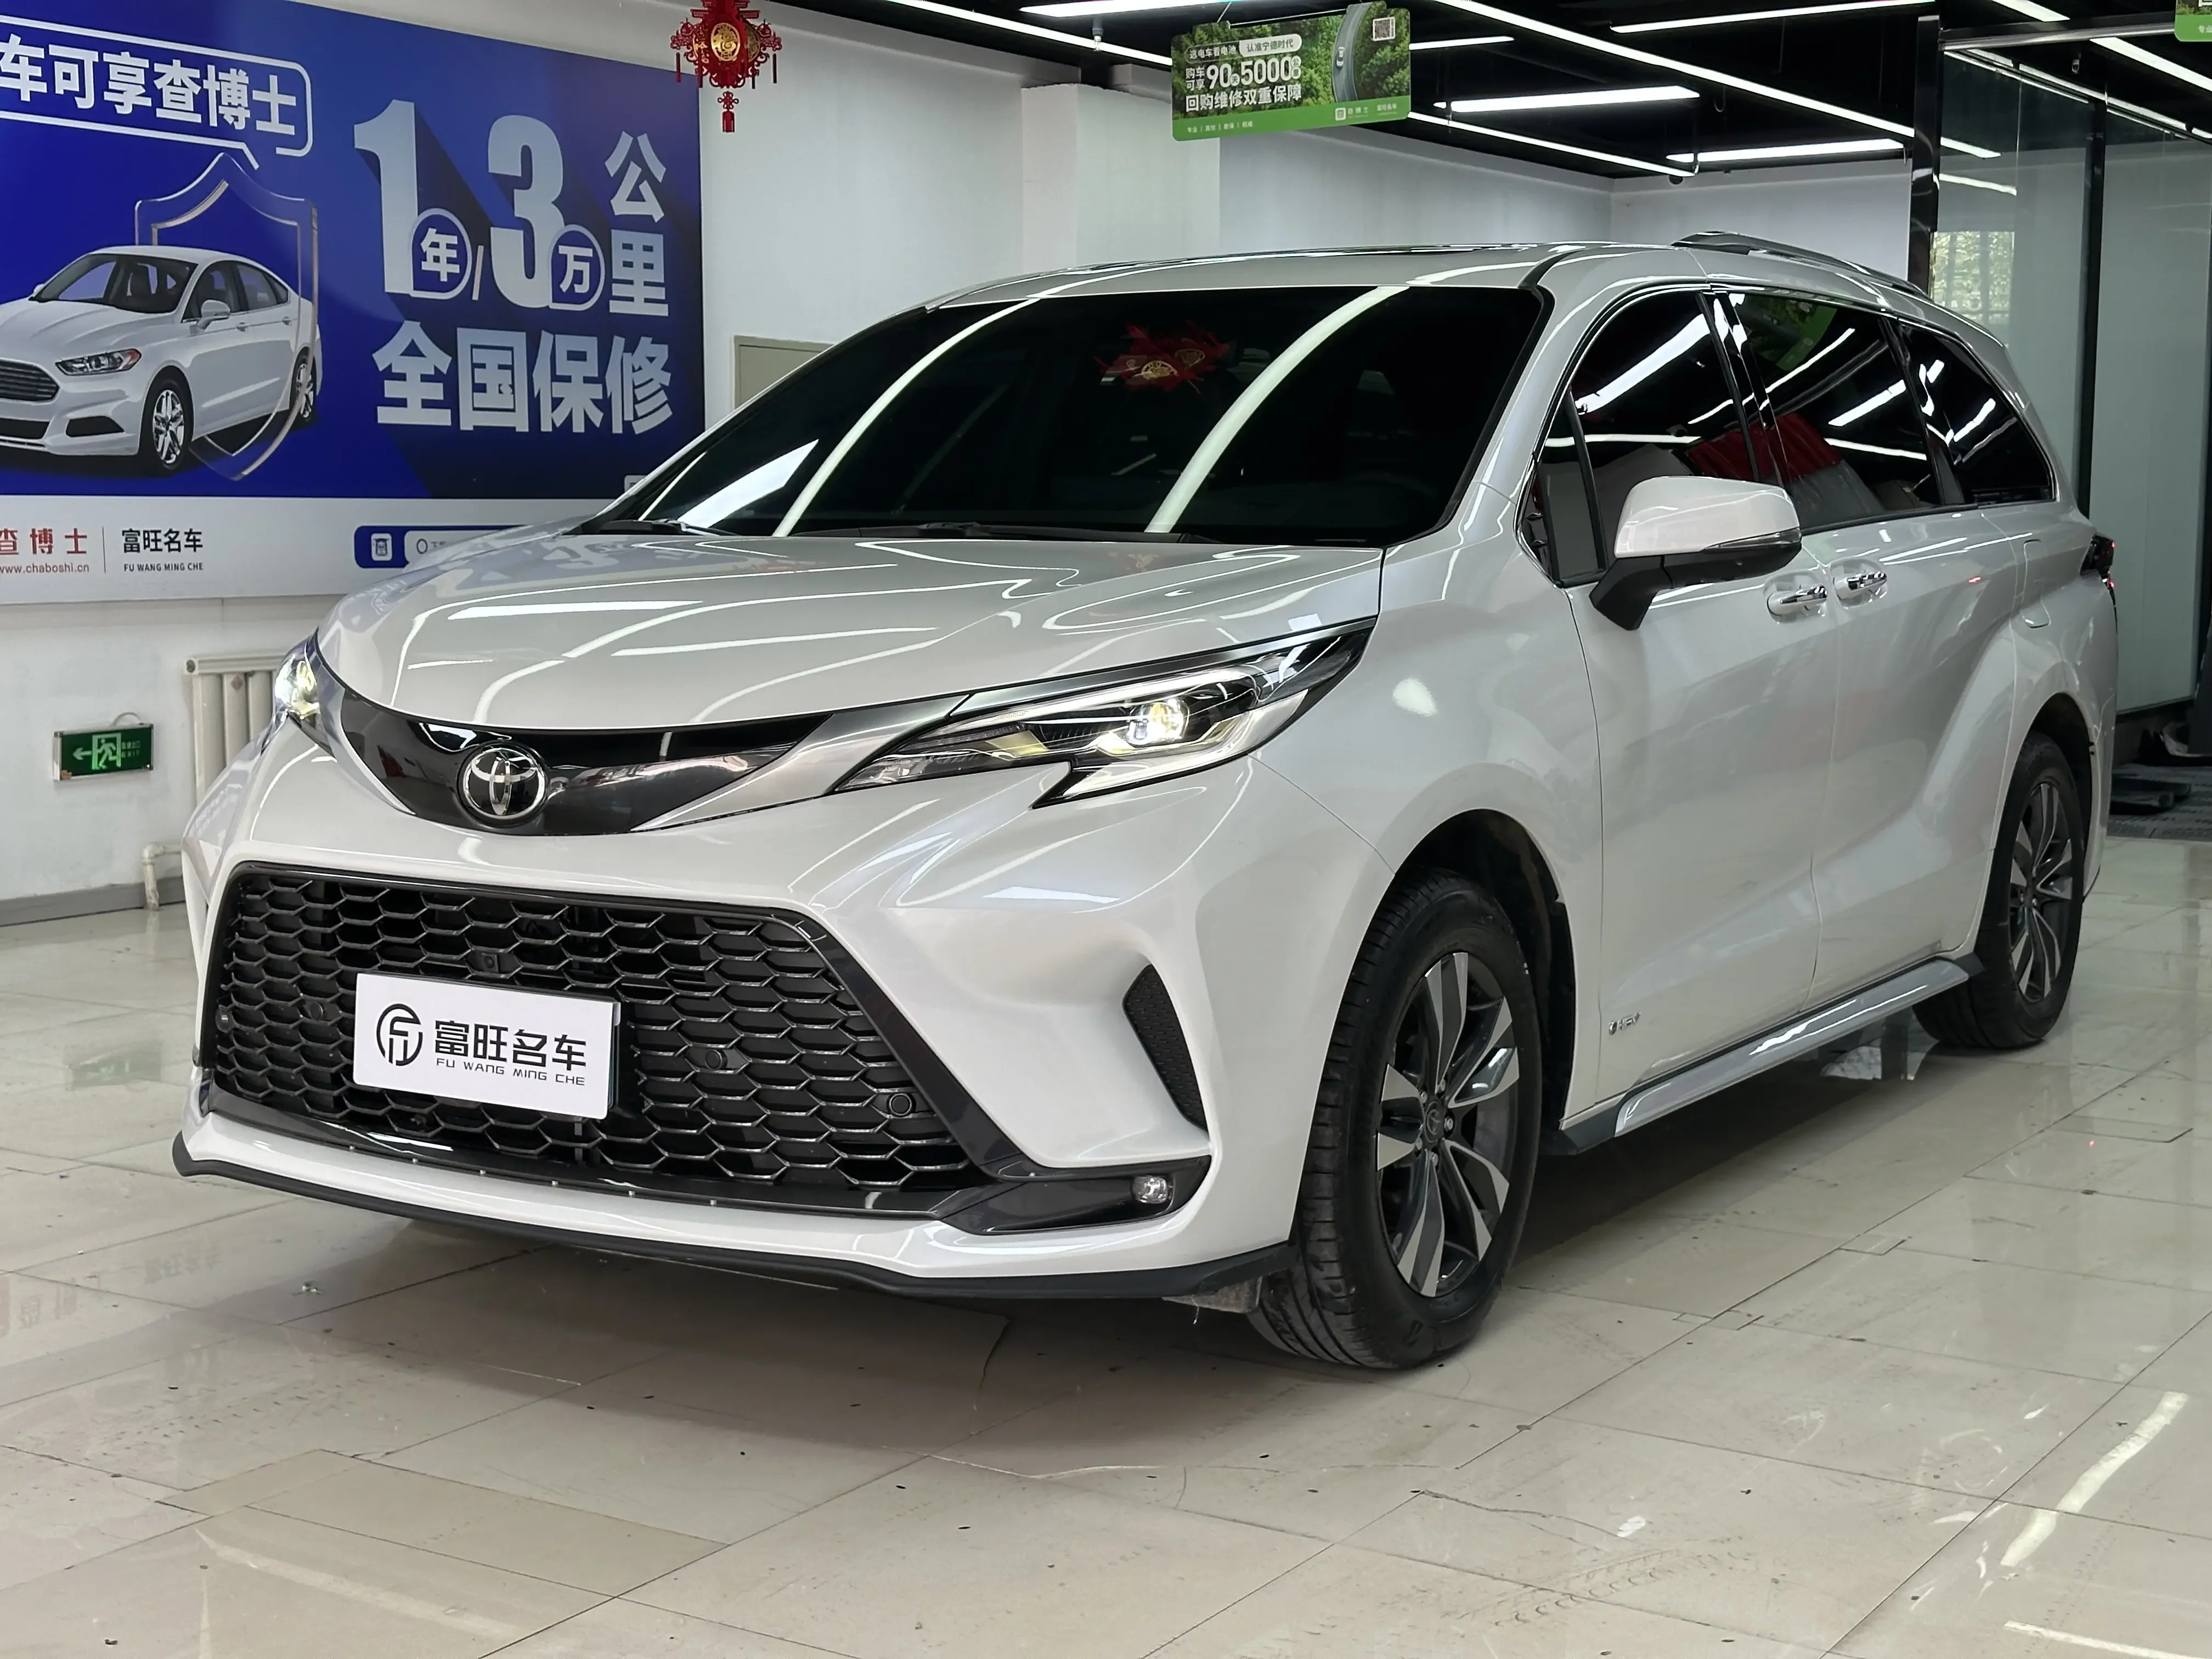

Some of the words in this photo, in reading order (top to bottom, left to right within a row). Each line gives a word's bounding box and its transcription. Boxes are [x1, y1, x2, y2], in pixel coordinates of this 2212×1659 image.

[0, 33, 296, 136] 车可享查博士
[1186, 83, 1302, 112] 回购维修双重保障
[372, 320, 673, 434] 全国保修
[0, 528, 87, 555] 查博士
[122, 528, 203, 553] 富旺名车
[138, 563, 161, 572] WANG
[164, 563, 185, 571] MING
[188, 562, 203, 571] CHE
[435, 1020, 586, 1070] 富旺名车
[437, 1058, 455, 1068] FU
[464, 1062, 505, 1075] WANG
[513, 1068, 546, 1080] MING
[556, 1074, 585, 1086] CHE
